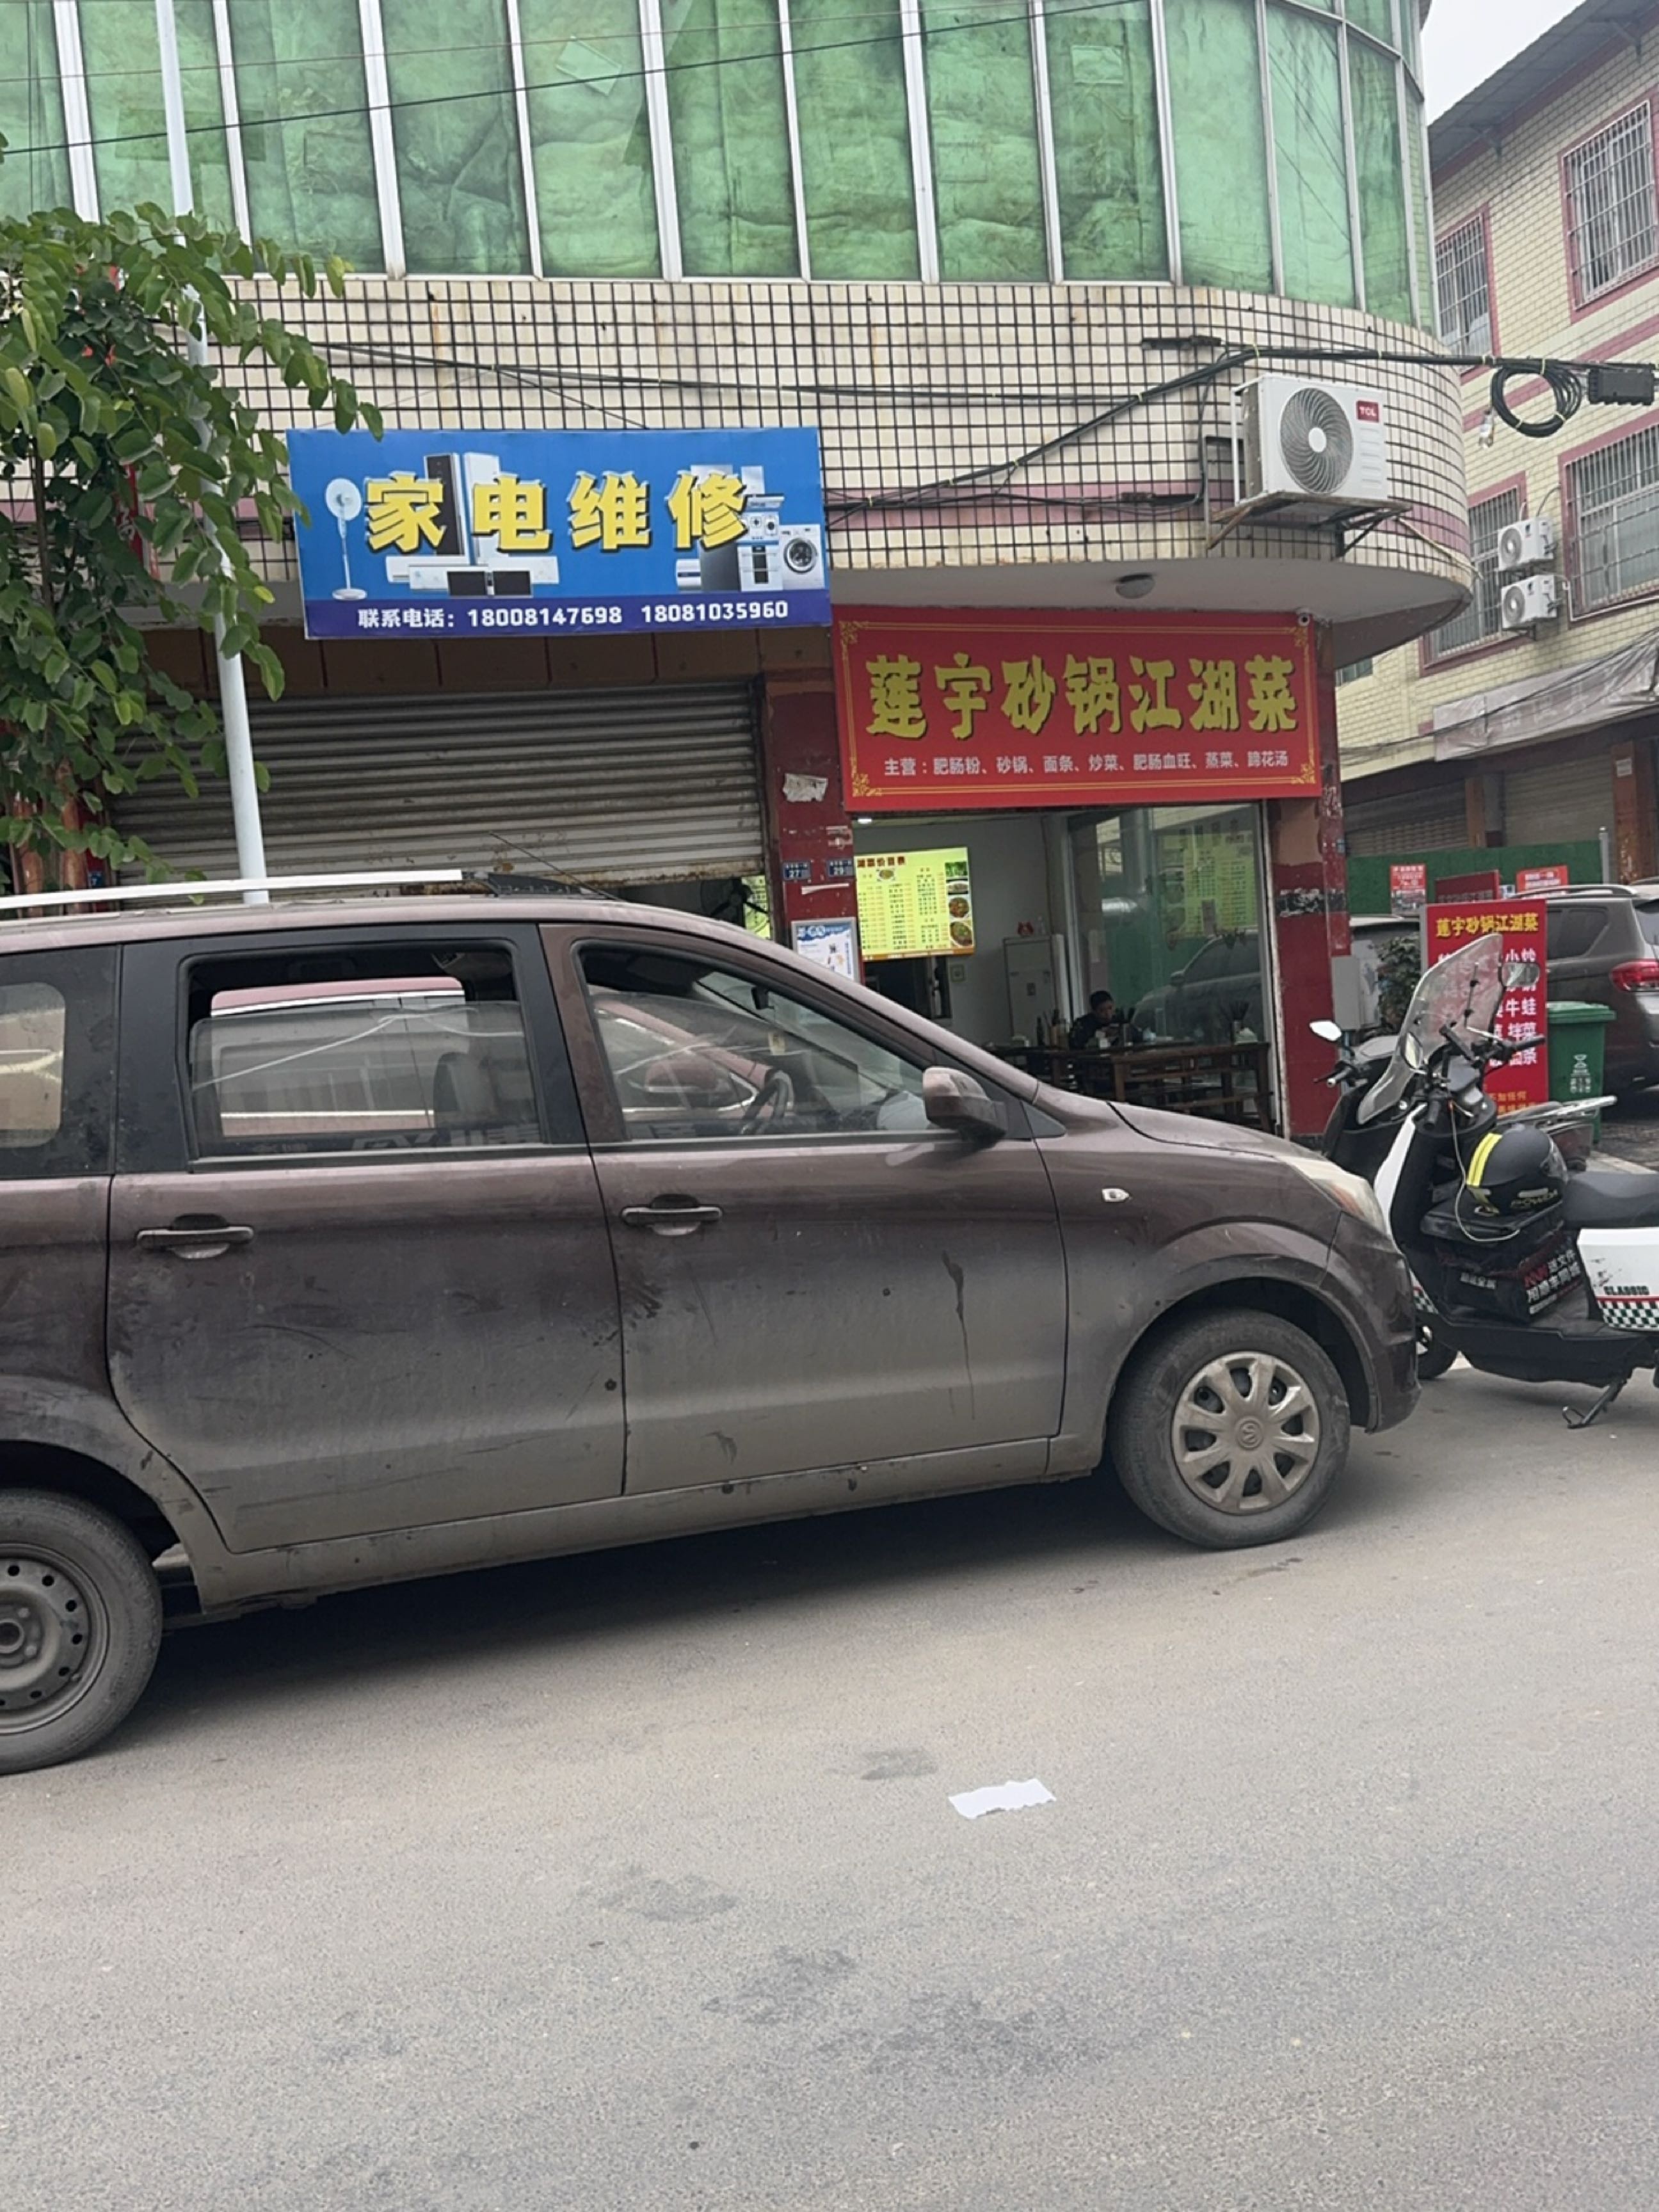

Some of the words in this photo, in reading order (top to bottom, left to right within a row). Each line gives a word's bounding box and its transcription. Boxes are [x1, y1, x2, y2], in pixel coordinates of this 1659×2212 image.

[1359, 406, 1377, 417] TCL
[364, 470, 748, 552] 家电维修
[641, 600, 789, 623] 18081035960
[865, 653, 1297, 739] 莲宇砂锅江湖菜
